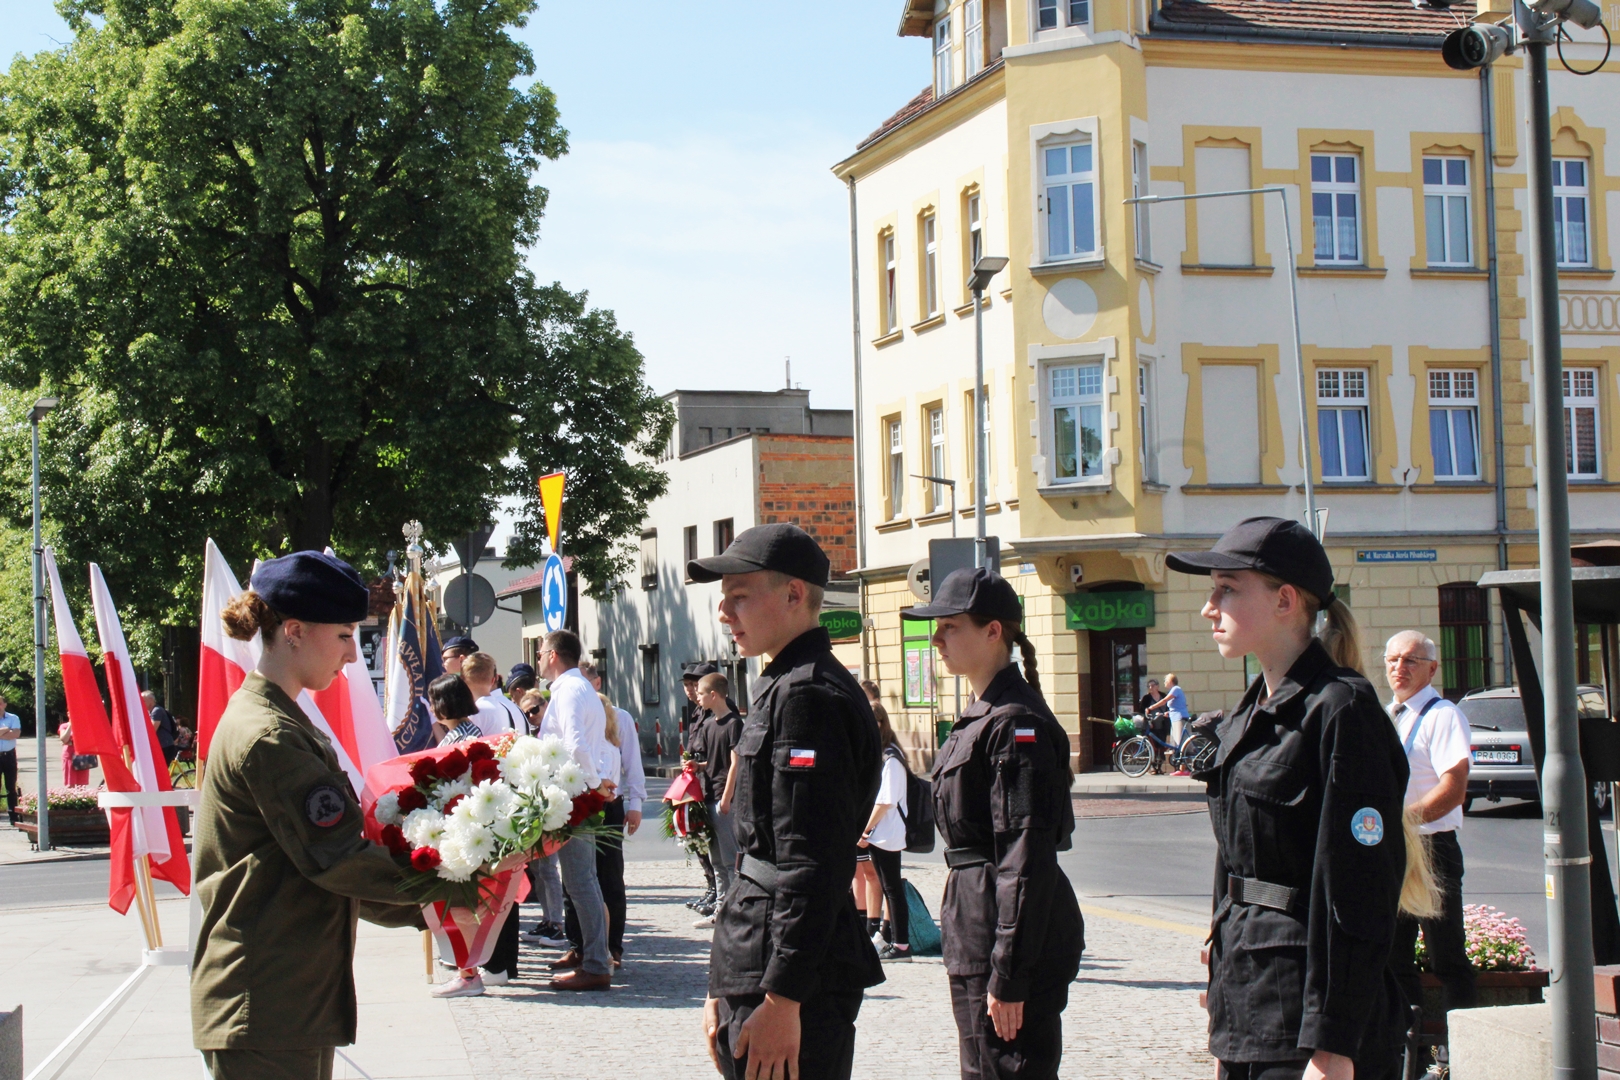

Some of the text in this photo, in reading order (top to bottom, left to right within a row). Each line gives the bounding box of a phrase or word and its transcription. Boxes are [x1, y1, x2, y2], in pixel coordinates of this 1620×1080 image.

[1071, 599, 1146, 622] żabka
[400, 640, 424, 682] AWŁA
[395, 711, 420, 751] ICZU
[1476, 751, 1494, 760] PRA
